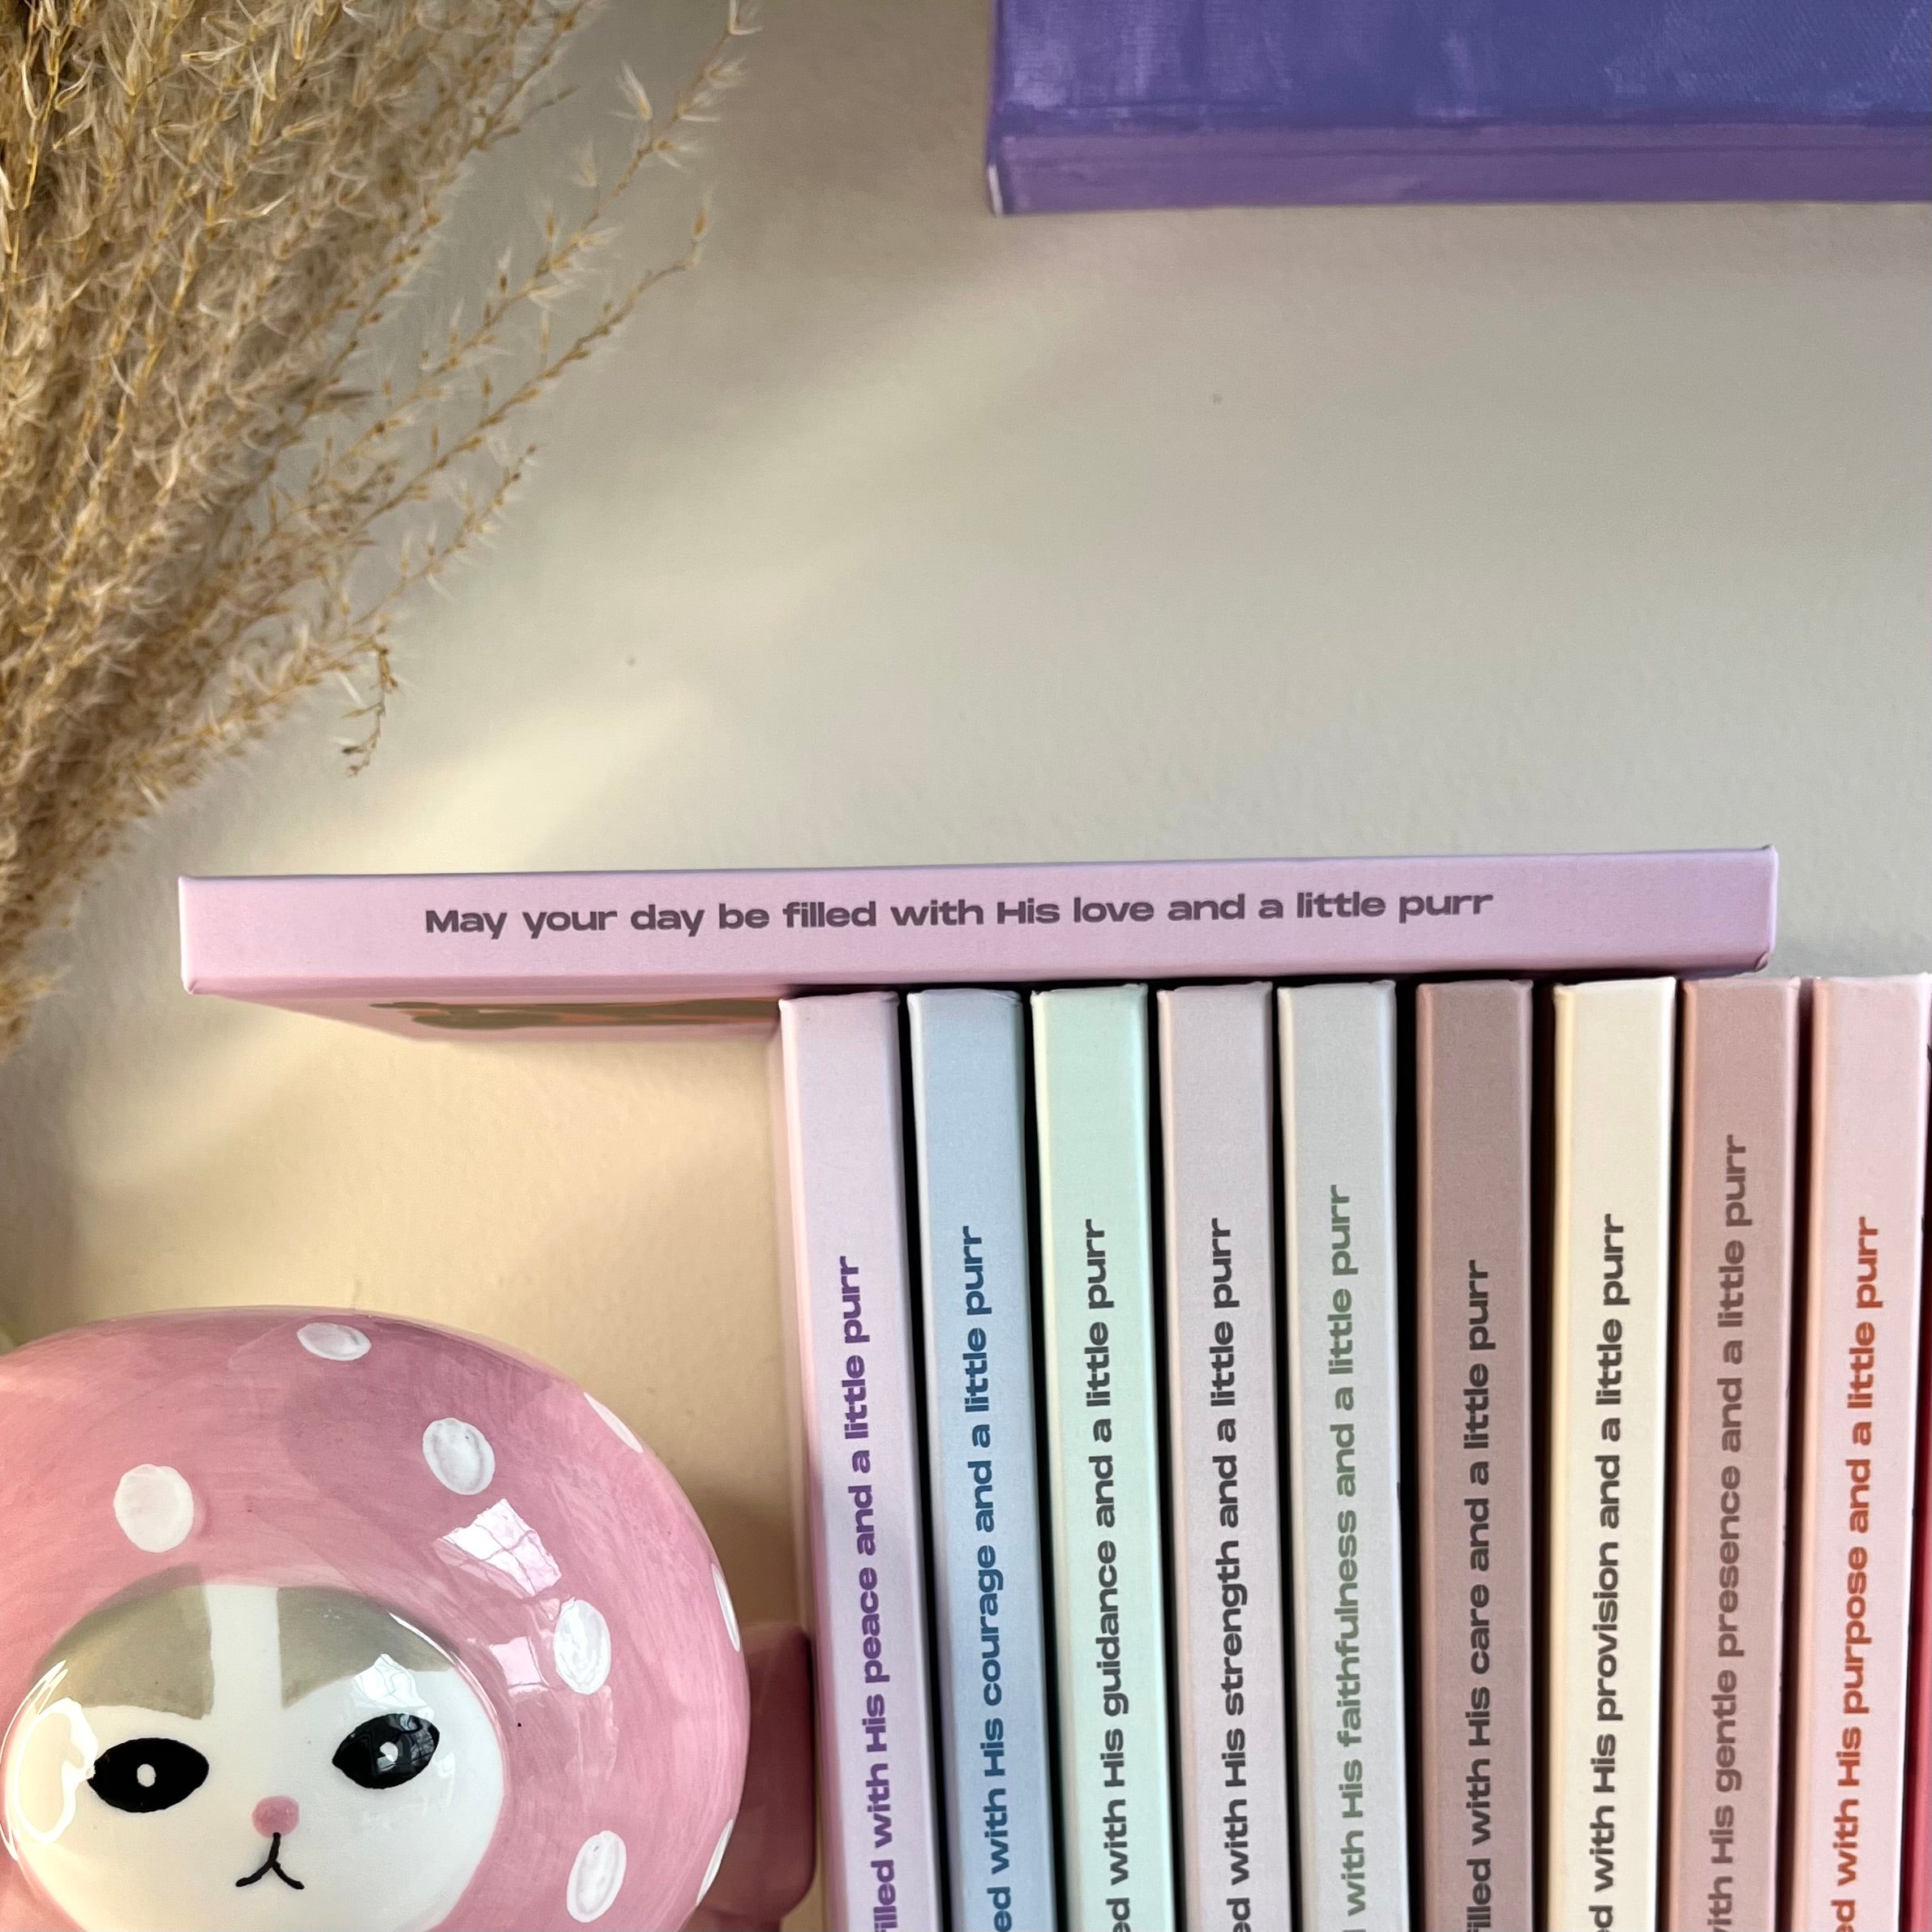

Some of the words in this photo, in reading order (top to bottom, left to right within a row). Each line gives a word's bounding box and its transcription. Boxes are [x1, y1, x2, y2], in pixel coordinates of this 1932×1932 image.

[425, 909, 508, 940] May
[521, 910, 618, 940] your
[630, 903, 705, 937] day
[718, 902, 770, 930] be
[782, 900, 877, 928] filled
[889, 898, 984, 927] with
[996, 897, 1060, 925] His
[1073, 896, 1154, 923] love
[1167, 893, 1246, 922] and
[1257, 898, 1284, 919] a
[1296, 891, 1386, 919] little
[1399, 893, 1494, 924] purr
[1724, 1133, 1754, 1227] purr
[962, 1225, 992, 1316] purr
[1085, 1219, 1115, 1310] purr
[1211, 1217, 1240, 1309] purr
[1330, 1184, 1359, 1276] purr
[1603, 1213, 1631, 1306] purr
[1856, 1215, 1884, 1309] purr
[839, 1255, 871, 1344] purr
[1468, 1259, 1497, 1351] purr
[1717, 1240, 1746, 1328] little
[962, 1327, 990, 1413] little
[1084, 1322, 1111, 1407] little
[1209, 1321, 1236, 1407] little
[1326, 1288, 1354, 1375] little
[1595, 1318, 1623, 1406] little
[1723, 1339, 1744, 1365] a
[1846, 1321, 1876, 1409] little
[841, 1355, 869, 1440] little
[971, 1424, 991, 1449] a
[1092, 1418, 1112, 1443] a
[1217, 1418, 1236, 1443] a
[1334, 1386, 1355, 1412] a
[1463, 1363, 1489, 1450] little
[1600, 1417, 1621, 1442] a
[1716, 1377, 1743, 1453] and
[1852, 1421, 1873, 1446] a
[851, 1450, 872, 1474] a
[966, 1459, 995, 1533] and
[1088, 1454, 1116, 1528] and
[1212, 1454, 1239, 1528] and
[1329, 1423, 1356, 1497] and
[1469, 1461, 1489, 1486] a
[1594, 1454, 1621, 1529] and
[1844, 1459, 1871, 1534] and
[847, 1484, 876, 1557] and
[1463, 1497, 1490, 1572] and
[1717, 1465, 1746, 1658] presence
[858, 1567, 891, 1684] peace
[977, 1544, 1005, 1707] courage
[1095, 1540, 1129, 1717] guidance
[1214, 1540, 1249, 1716] strength
[1334, 1510, 1362, 1748] faithfulness
[1470, 1583, 1490, 1675] care
[1591, 1541, 1624, 1721] provision
[1843, 1546, 1873, 1715] purpose
[861, 1694, 888, 1753] His
[979, 1717, 1006, 1777] His
[1099, 1728, 1125, 1788] His
[1221, 1728, 1247, 1788] His
[1464, 1686, 1491, 1747] His
[1711, 1669, 1743, 1793] gentle
[1836, 1726, 1862, 1787] His
[865, 1763, 893, 1848] with
[1338, 1759, 1364, 1818] His
[1465, 1758, 1491, 1847] with
[1590, 1733, 1617, 1793] His
[983, 1788, 1010, 1875] with
[1102, 1798, 1129, 1886] with
[1223, 1798, 1250, 1886] with
[1339, 1830, 1366, 1917] with
[1589, 1805, 1616, 1893] with
[1708, 1805, 1735, 1865] His
[1831, 1798, 1860, 1887] with
[870, 1859, 898, 1932] illed
[1466, 1857, 1492, 1932] illed
[1588, 1904, 1613, 1932] d
[1707, 1875, 1734, 1932] ith
